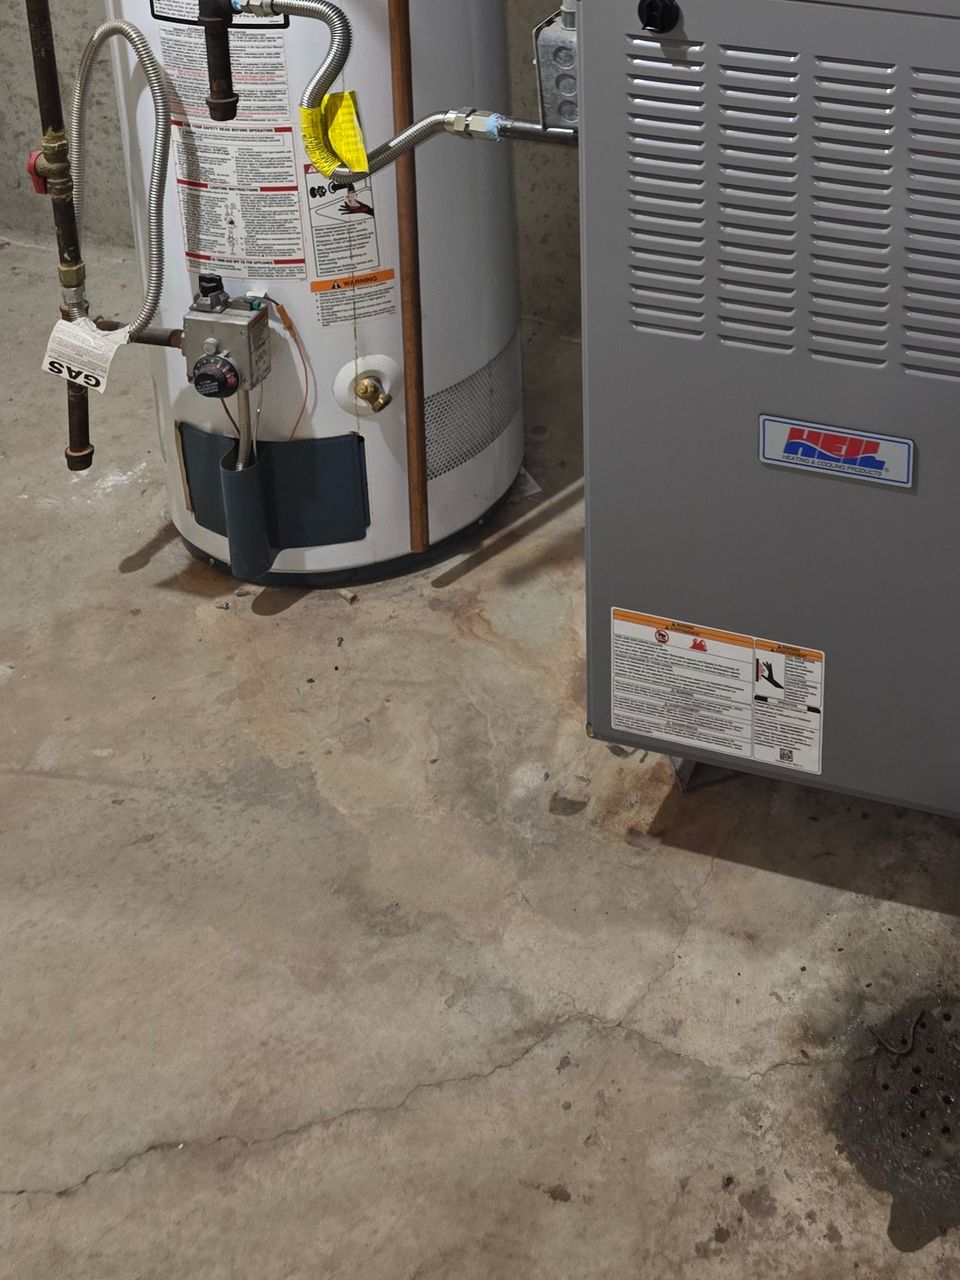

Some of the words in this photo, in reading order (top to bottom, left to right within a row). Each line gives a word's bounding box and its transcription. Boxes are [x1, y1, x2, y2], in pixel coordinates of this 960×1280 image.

[342, 275, 378, 288] WARNING
[48, 360, 102, 388] GAS
[783, 426, 886, 471] HEIL
[782, 454, 811, 465] HEATING
[816, 460, 846, 471] COOLING
[846, 465, 883, 477] PRODUCTS
